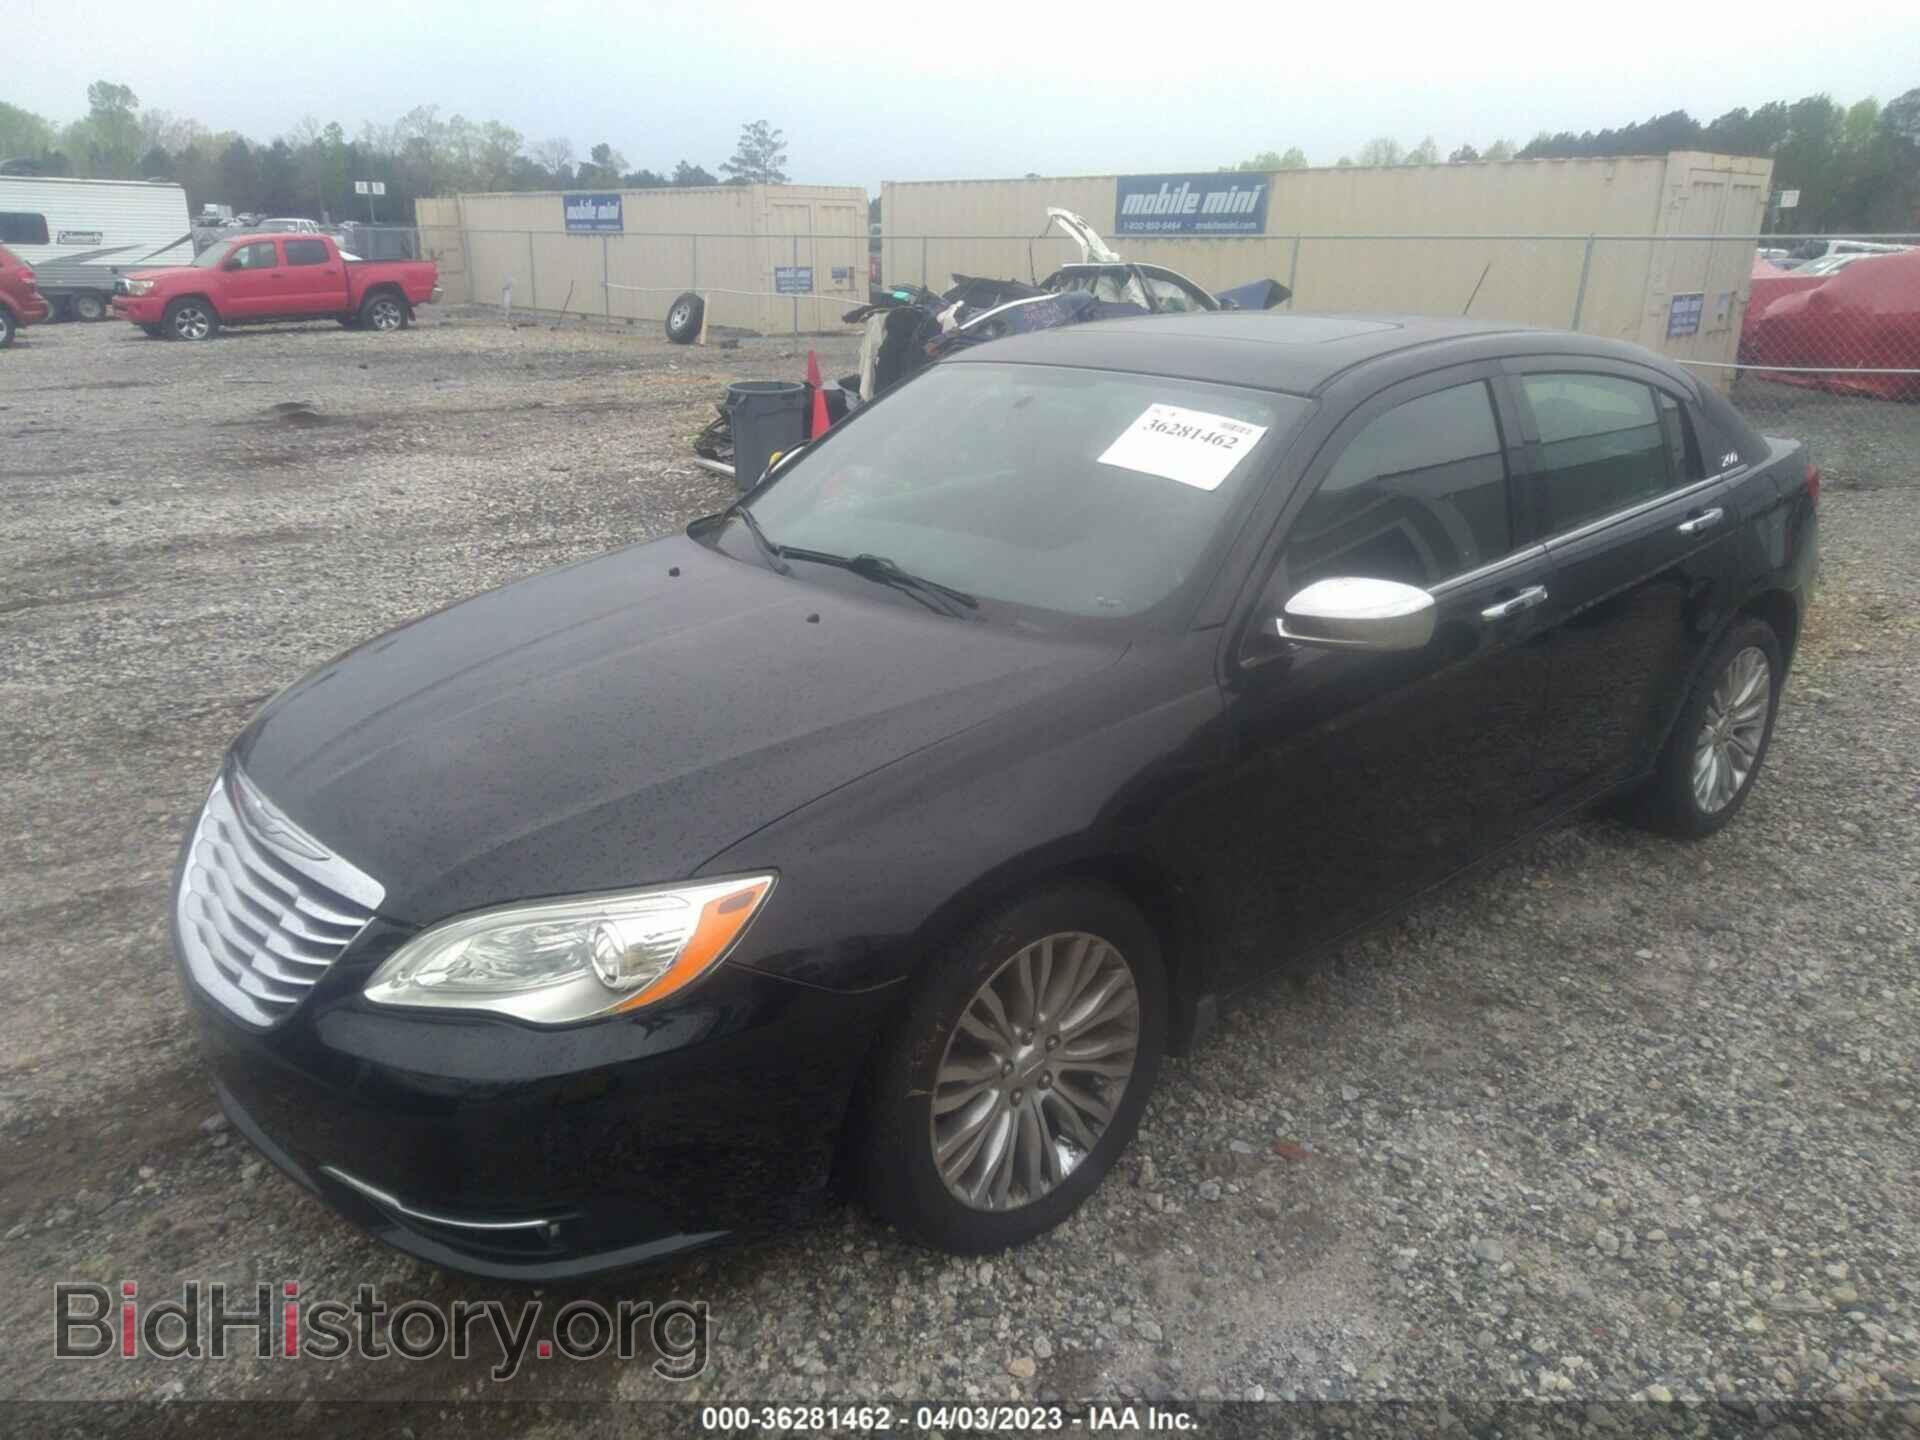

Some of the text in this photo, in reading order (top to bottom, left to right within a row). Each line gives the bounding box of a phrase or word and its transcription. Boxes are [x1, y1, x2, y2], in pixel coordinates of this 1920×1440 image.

[1121, 182, 1266, 214] mobile mini
[1143, 418, 1239, 449] 36281462
